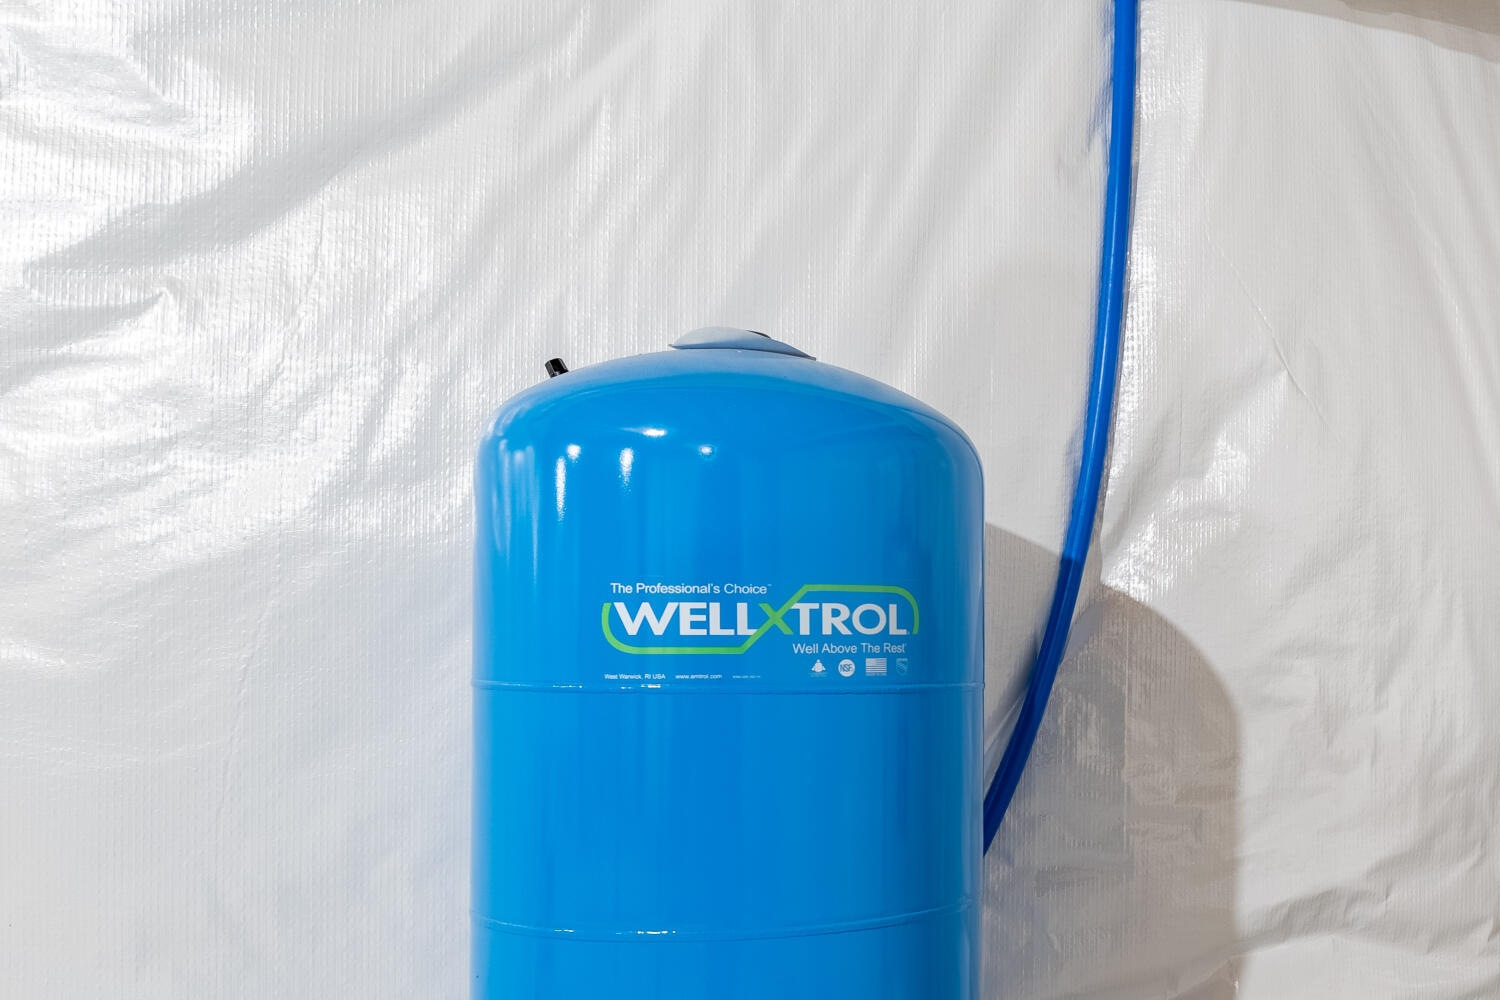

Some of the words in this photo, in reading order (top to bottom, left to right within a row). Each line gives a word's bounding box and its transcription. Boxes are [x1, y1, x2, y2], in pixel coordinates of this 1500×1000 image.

[611, 583, 632, 594] The
[636, 583, 720, 594] Professional's
[724, 583, 767, 595] Choice
[792, 643, 819, 654] Well
[822, 643, 857, 654] Above
[860, 643, 881, 653] The
[883, 643, 905, 654] Rest
